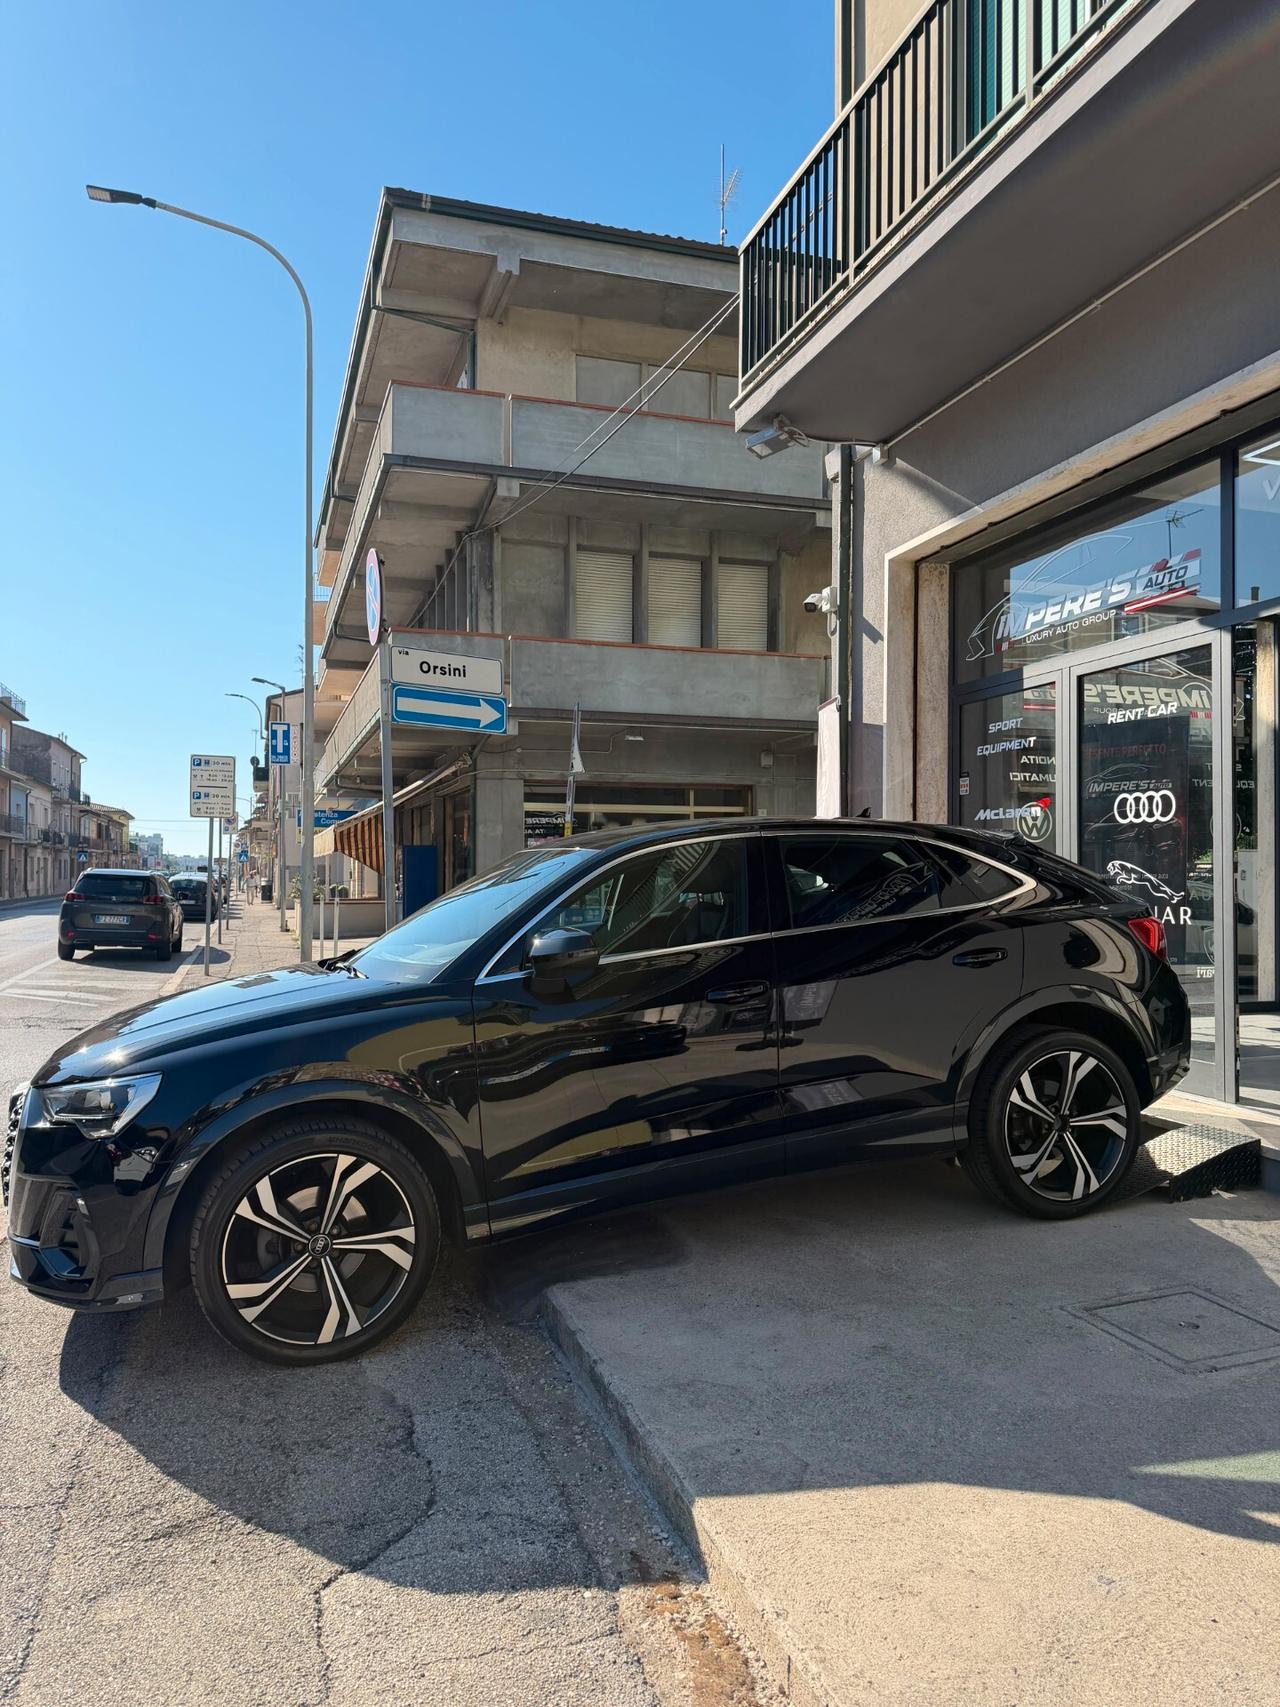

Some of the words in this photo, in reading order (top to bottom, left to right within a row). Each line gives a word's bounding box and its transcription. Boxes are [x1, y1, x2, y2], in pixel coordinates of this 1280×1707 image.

[1143, 565, 1189, 591] AUTO
[1056, 621, 1080, 635] AUTO
[1081, 609, 1117, 627] GROUP
[419, 660, 466, 678] Orsini
[1107, 707, 1145, 725] RENT
[1147, 702, 1178, 718] CAR
[988, 717, 1024, 733] SPORT
[976, 737, 1037, 756] EQUIPMENT
[974, 807, 1041, 821] McLaren
